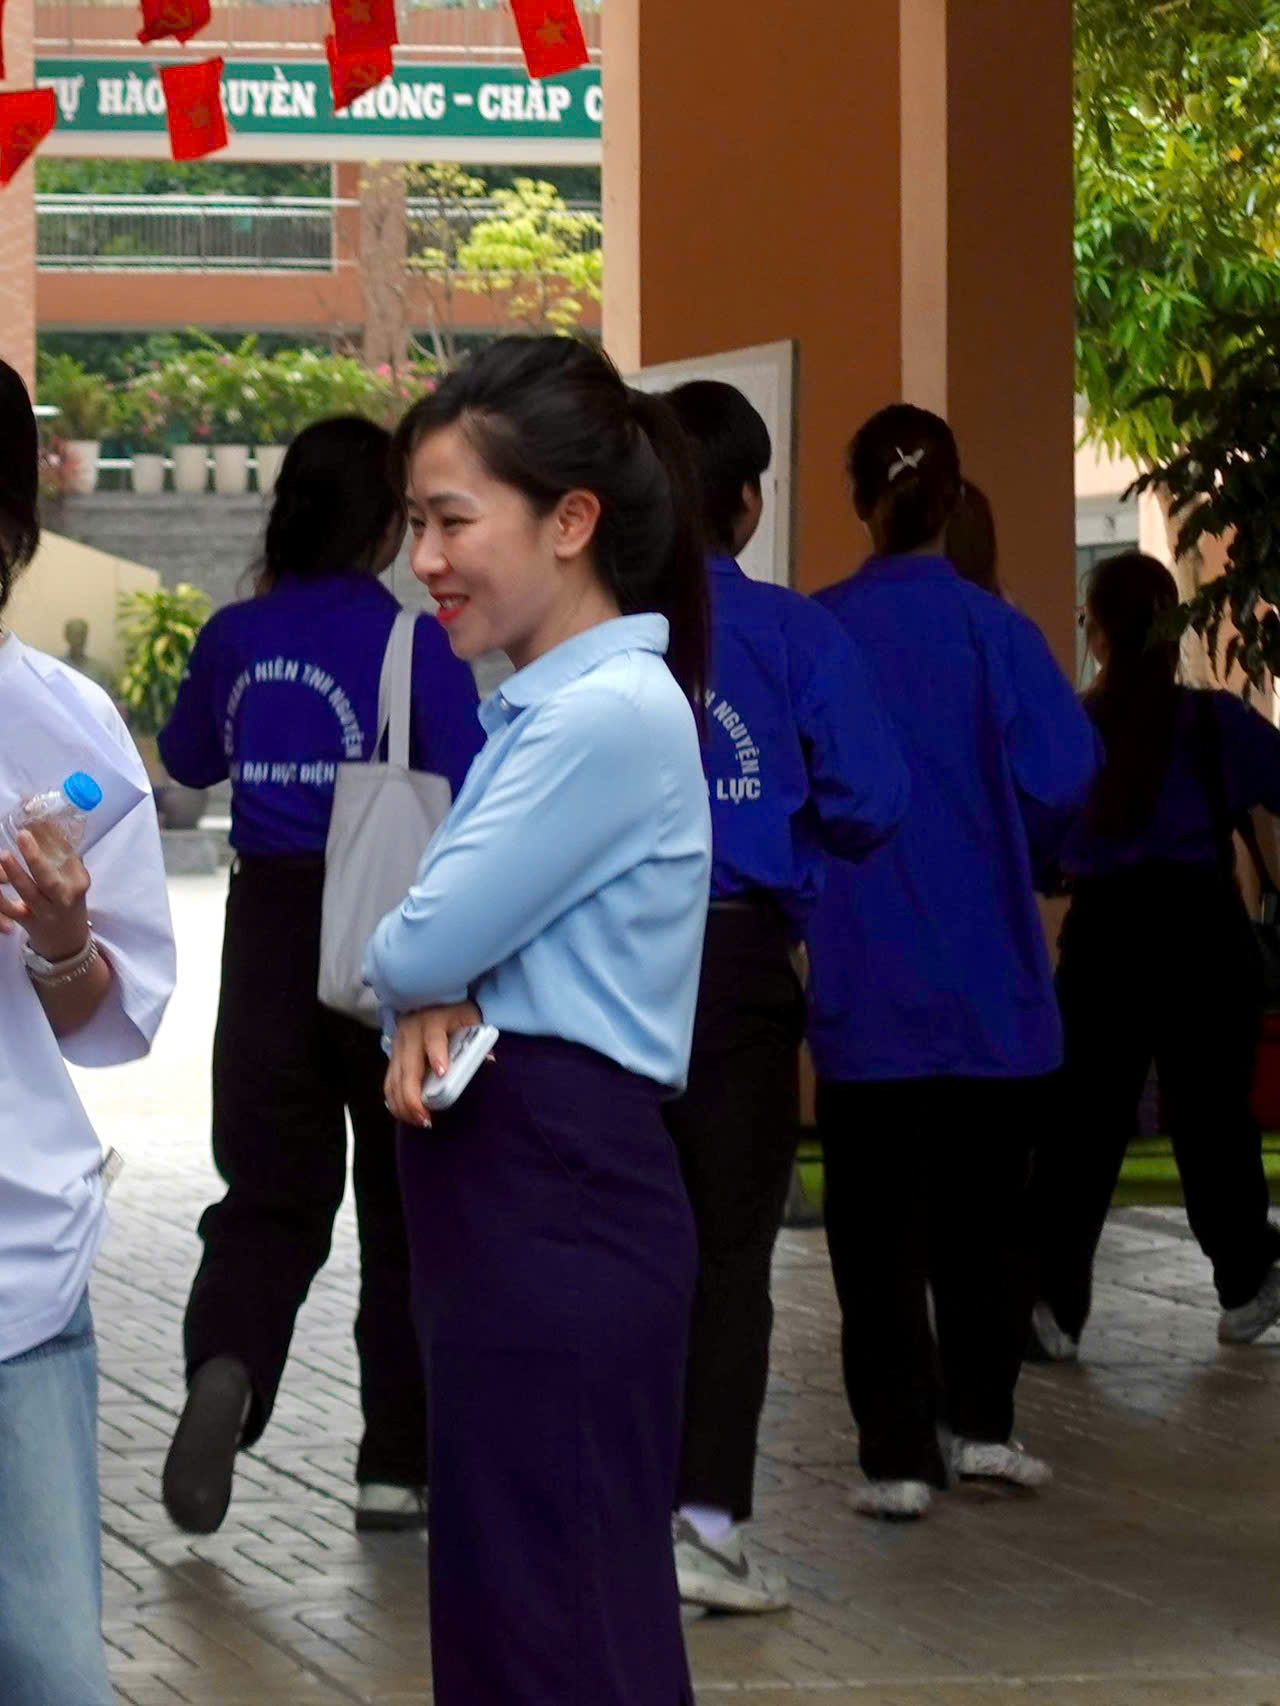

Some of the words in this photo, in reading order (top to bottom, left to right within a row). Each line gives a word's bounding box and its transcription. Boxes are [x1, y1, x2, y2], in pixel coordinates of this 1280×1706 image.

[97, 70, 167, 116] HÀO
[712, 699, 761, 775] NGUYỆN
[716, 776, 761, 806] LỰC
